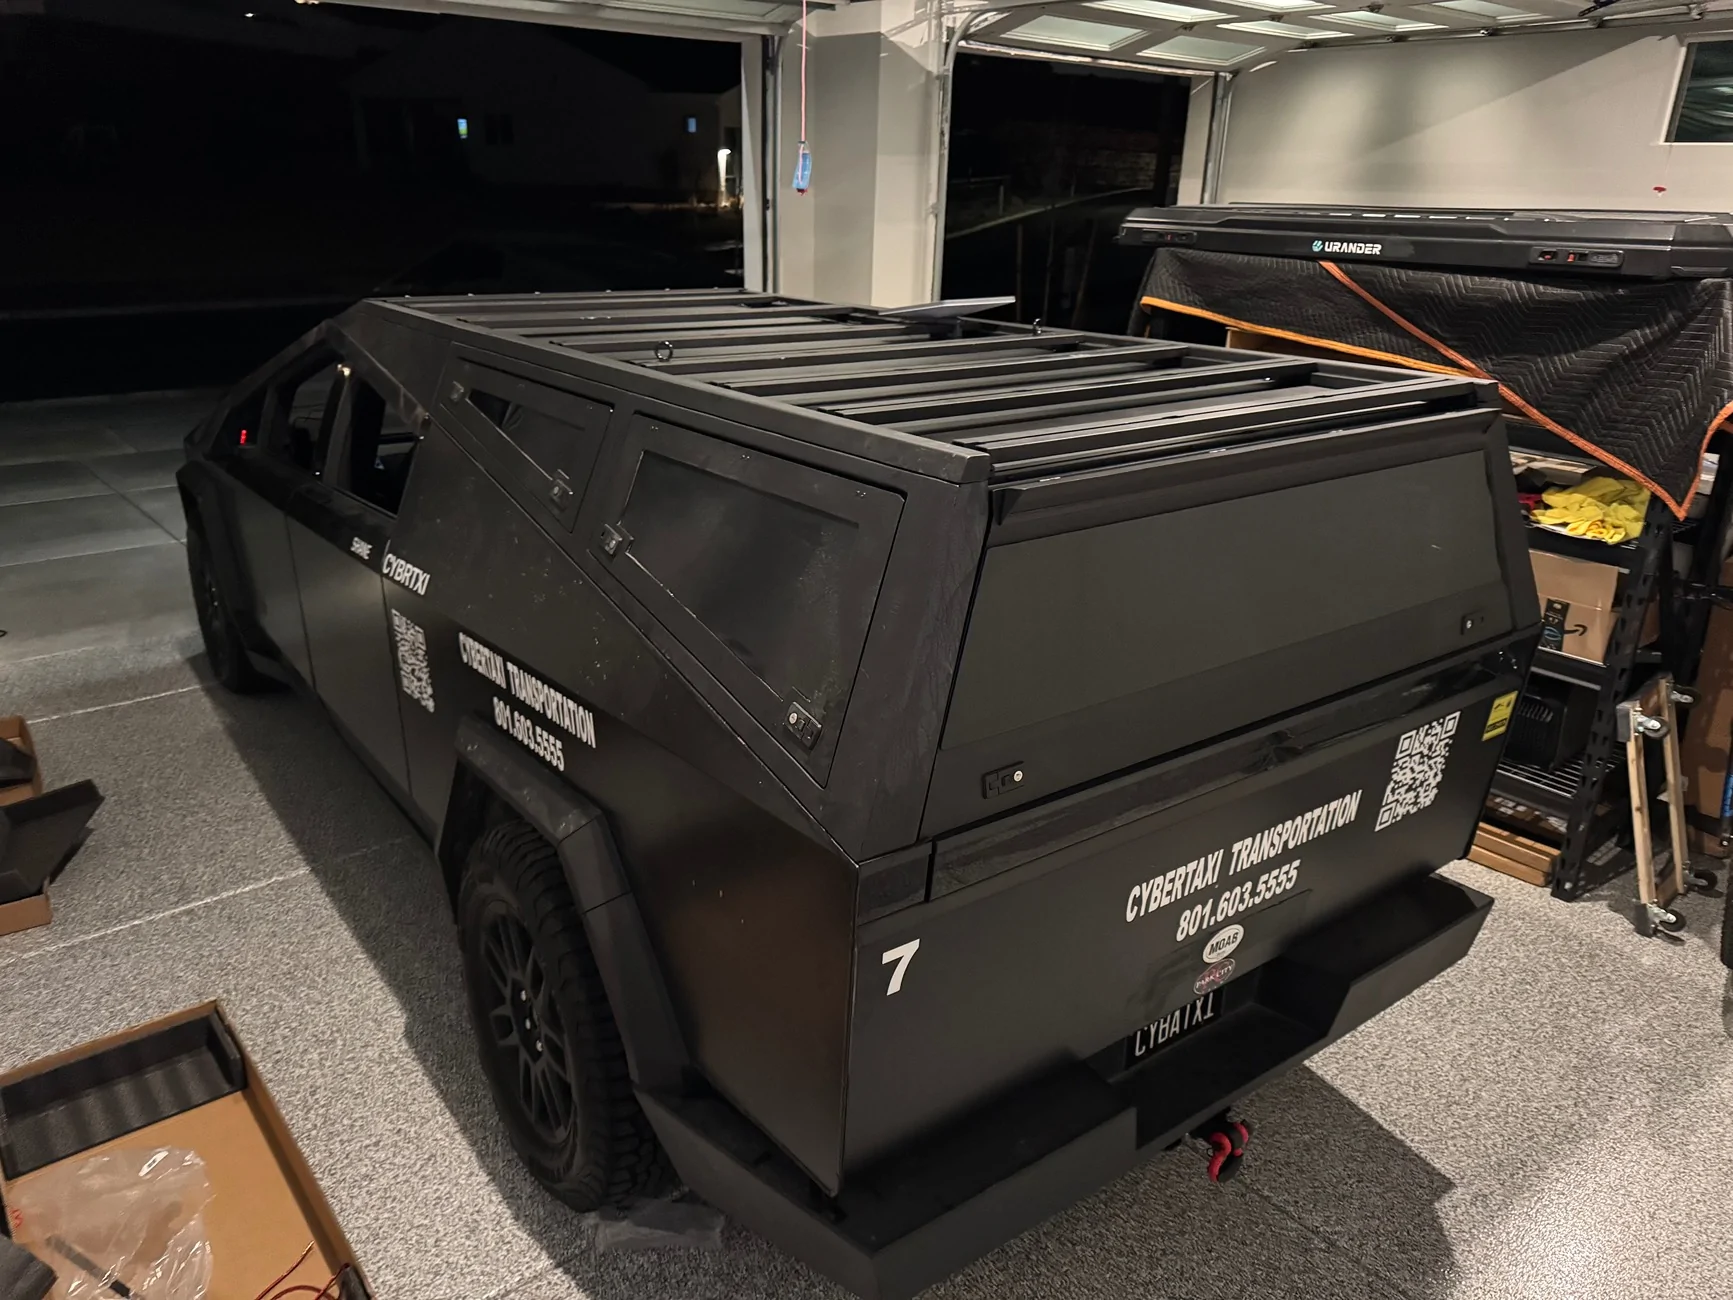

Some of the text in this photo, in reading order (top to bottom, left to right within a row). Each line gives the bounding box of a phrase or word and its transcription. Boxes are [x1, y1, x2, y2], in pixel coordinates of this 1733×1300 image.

[1324, 241, 1382, 255] URANDER
[382, 553, 431, 596] CYBRTXI
[458, 632, 597, 749] CYBERTAXI TRANSPORTATION
[493, 696, 565, 772] 801.603.5555
[1126, 789, 1363, 923] CYBERTAXI TRANSPORTATION
[1175, 859, 1302, 942] 801.603.5555
[882, 938, 921, 996] 7
[1208, 931, 1239, 956] MOAB
